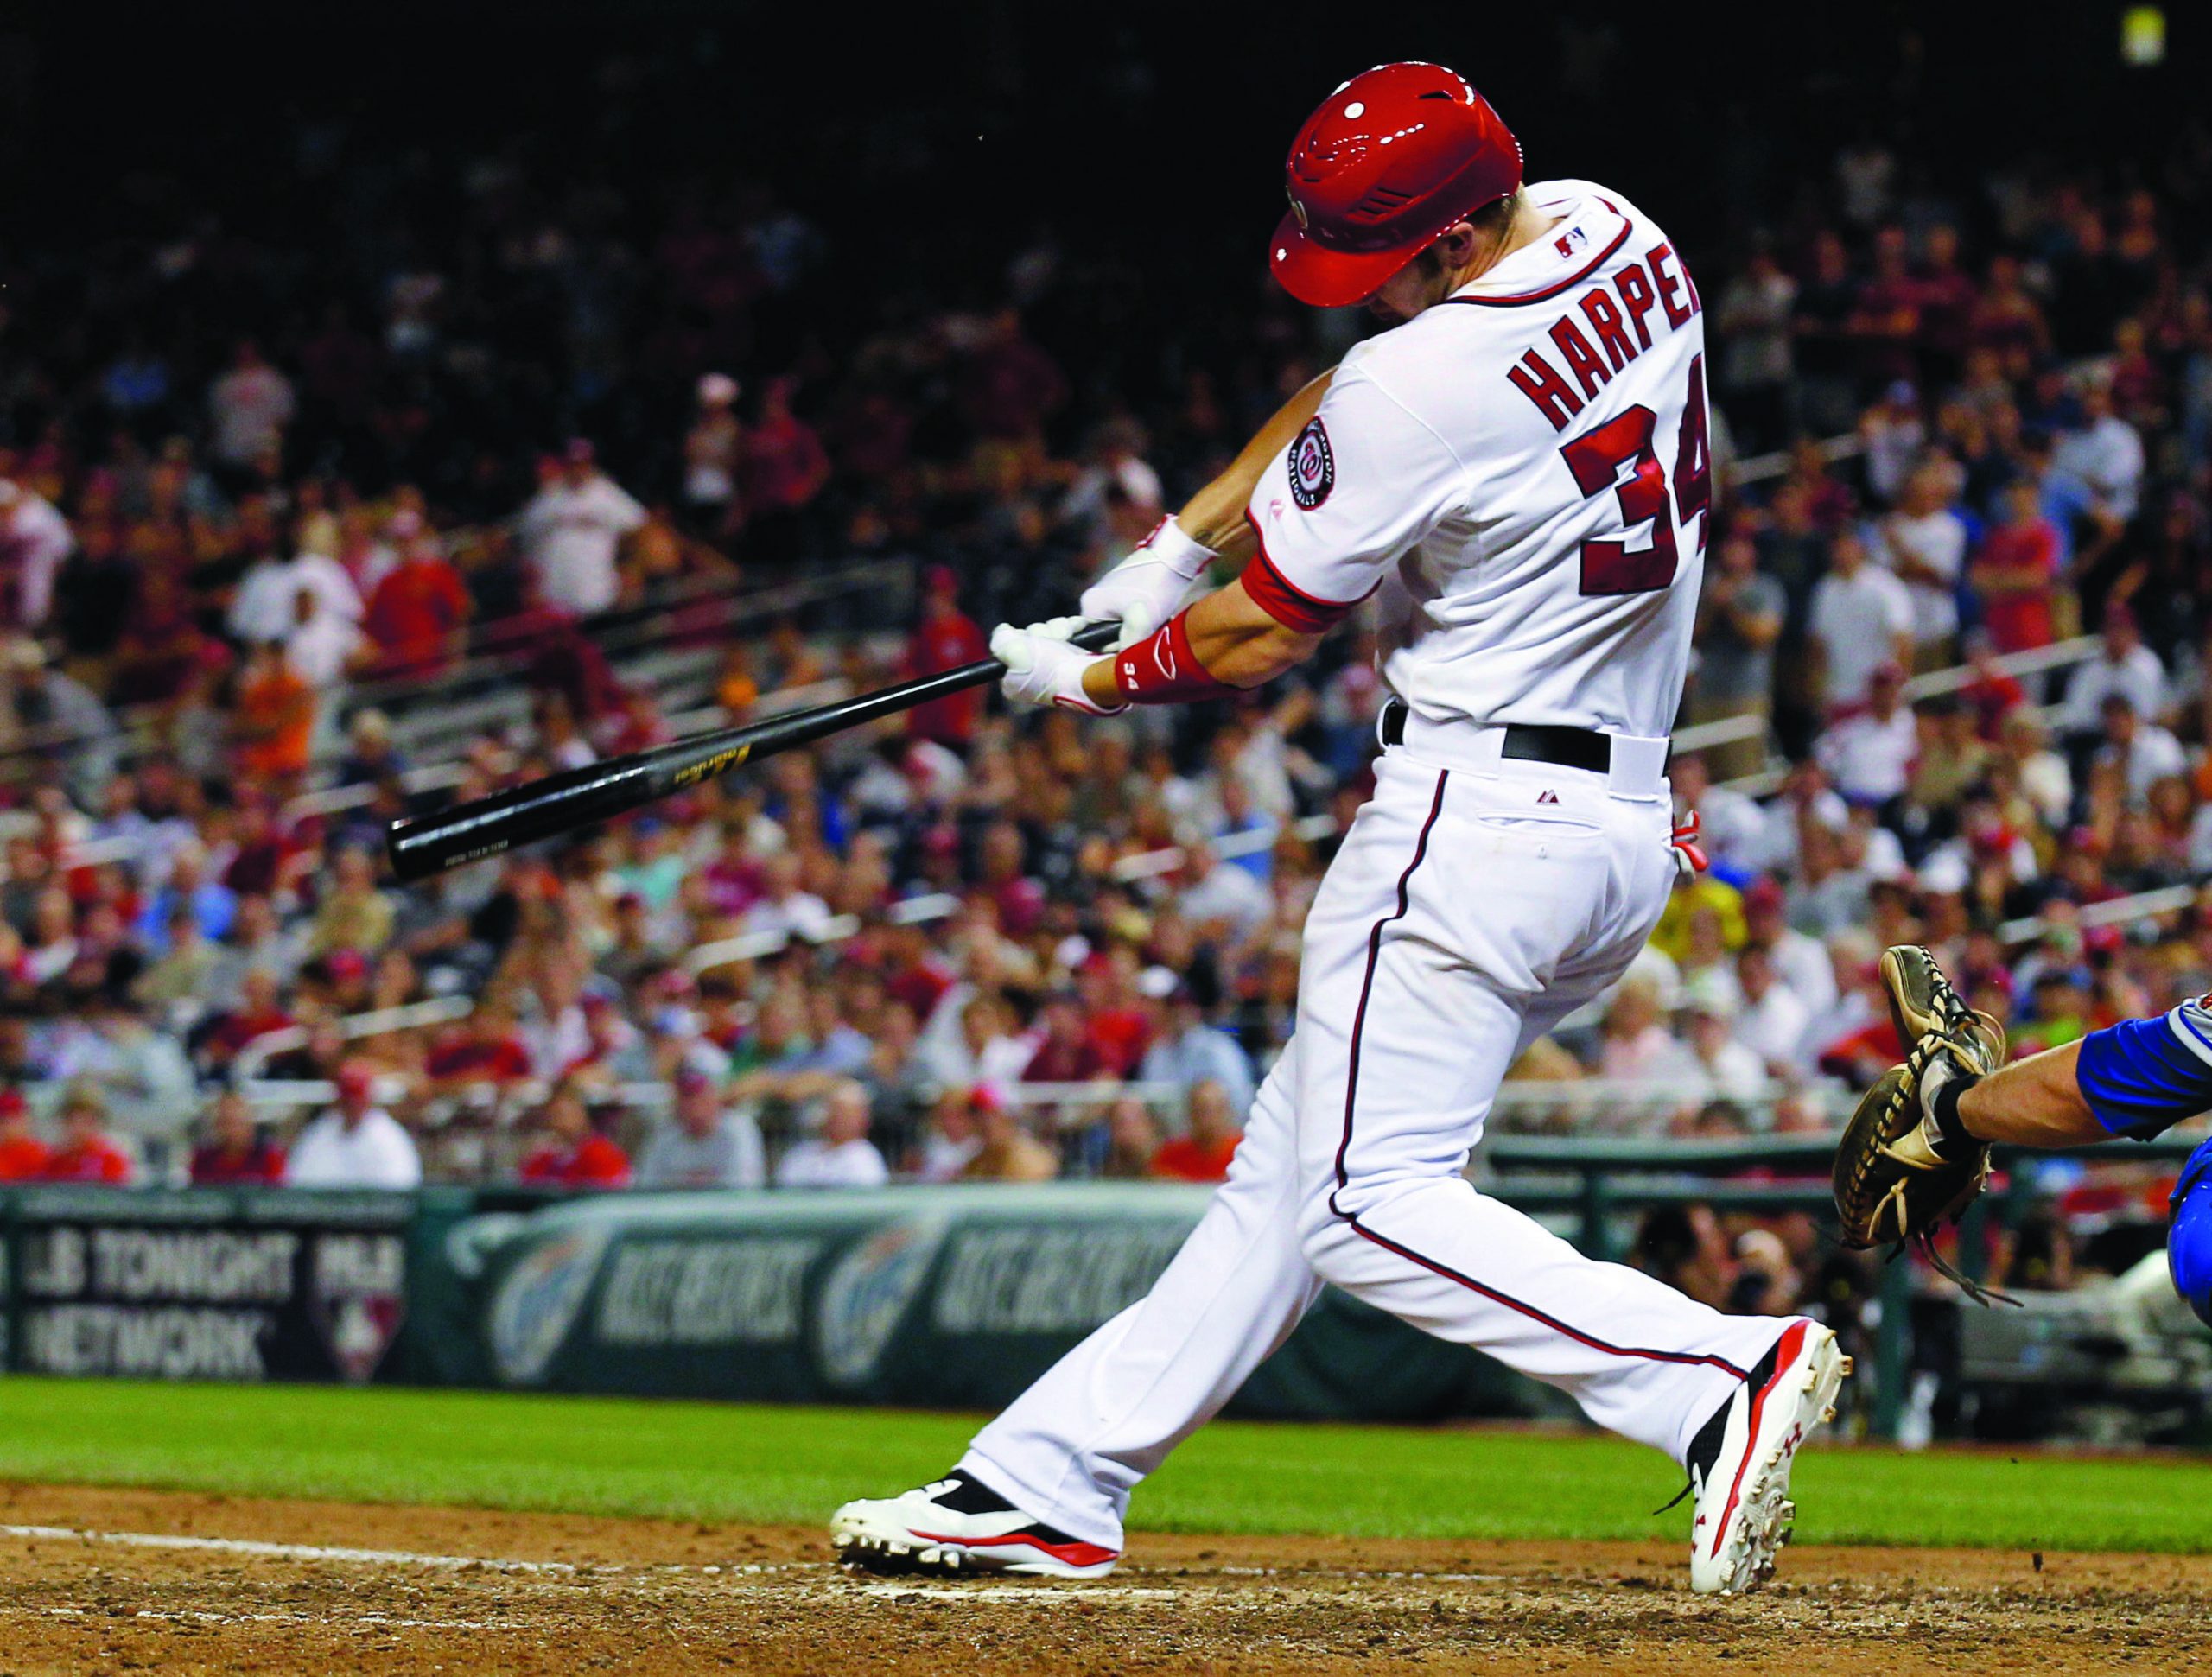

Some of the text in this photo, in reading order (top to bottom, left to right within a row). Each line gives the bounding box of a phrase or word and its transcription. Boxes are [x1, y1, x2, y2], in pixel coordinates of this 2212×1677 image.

[1559, 353, 1711, 596] 34
[1124, 662, 1140, 690] 34
[93, 1229, 299, 1299] TONIGHT
[25, 1304, 267, 1375] NETWORK
